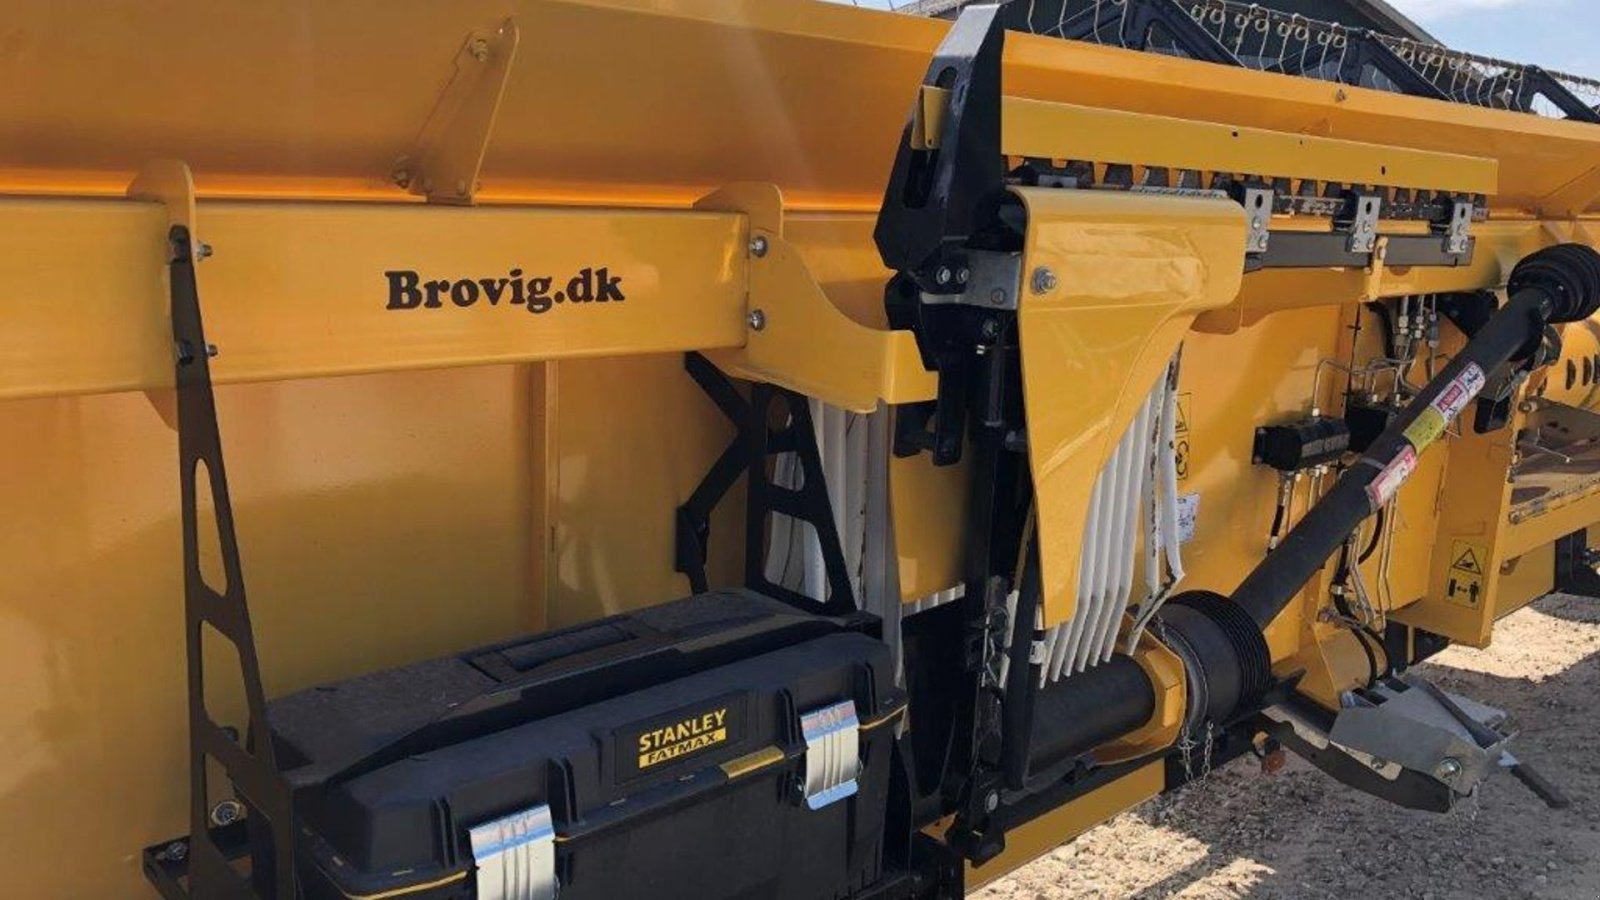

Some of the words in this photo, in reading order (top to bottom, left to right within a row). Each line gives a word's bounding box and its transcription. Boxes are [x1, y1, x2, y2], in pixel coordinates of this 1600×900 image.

[385, 267, 625, 314] Brovig.dk
[639, 709, 726, 752] STANLEY
[648, 732, 717, 764] FATMAX
